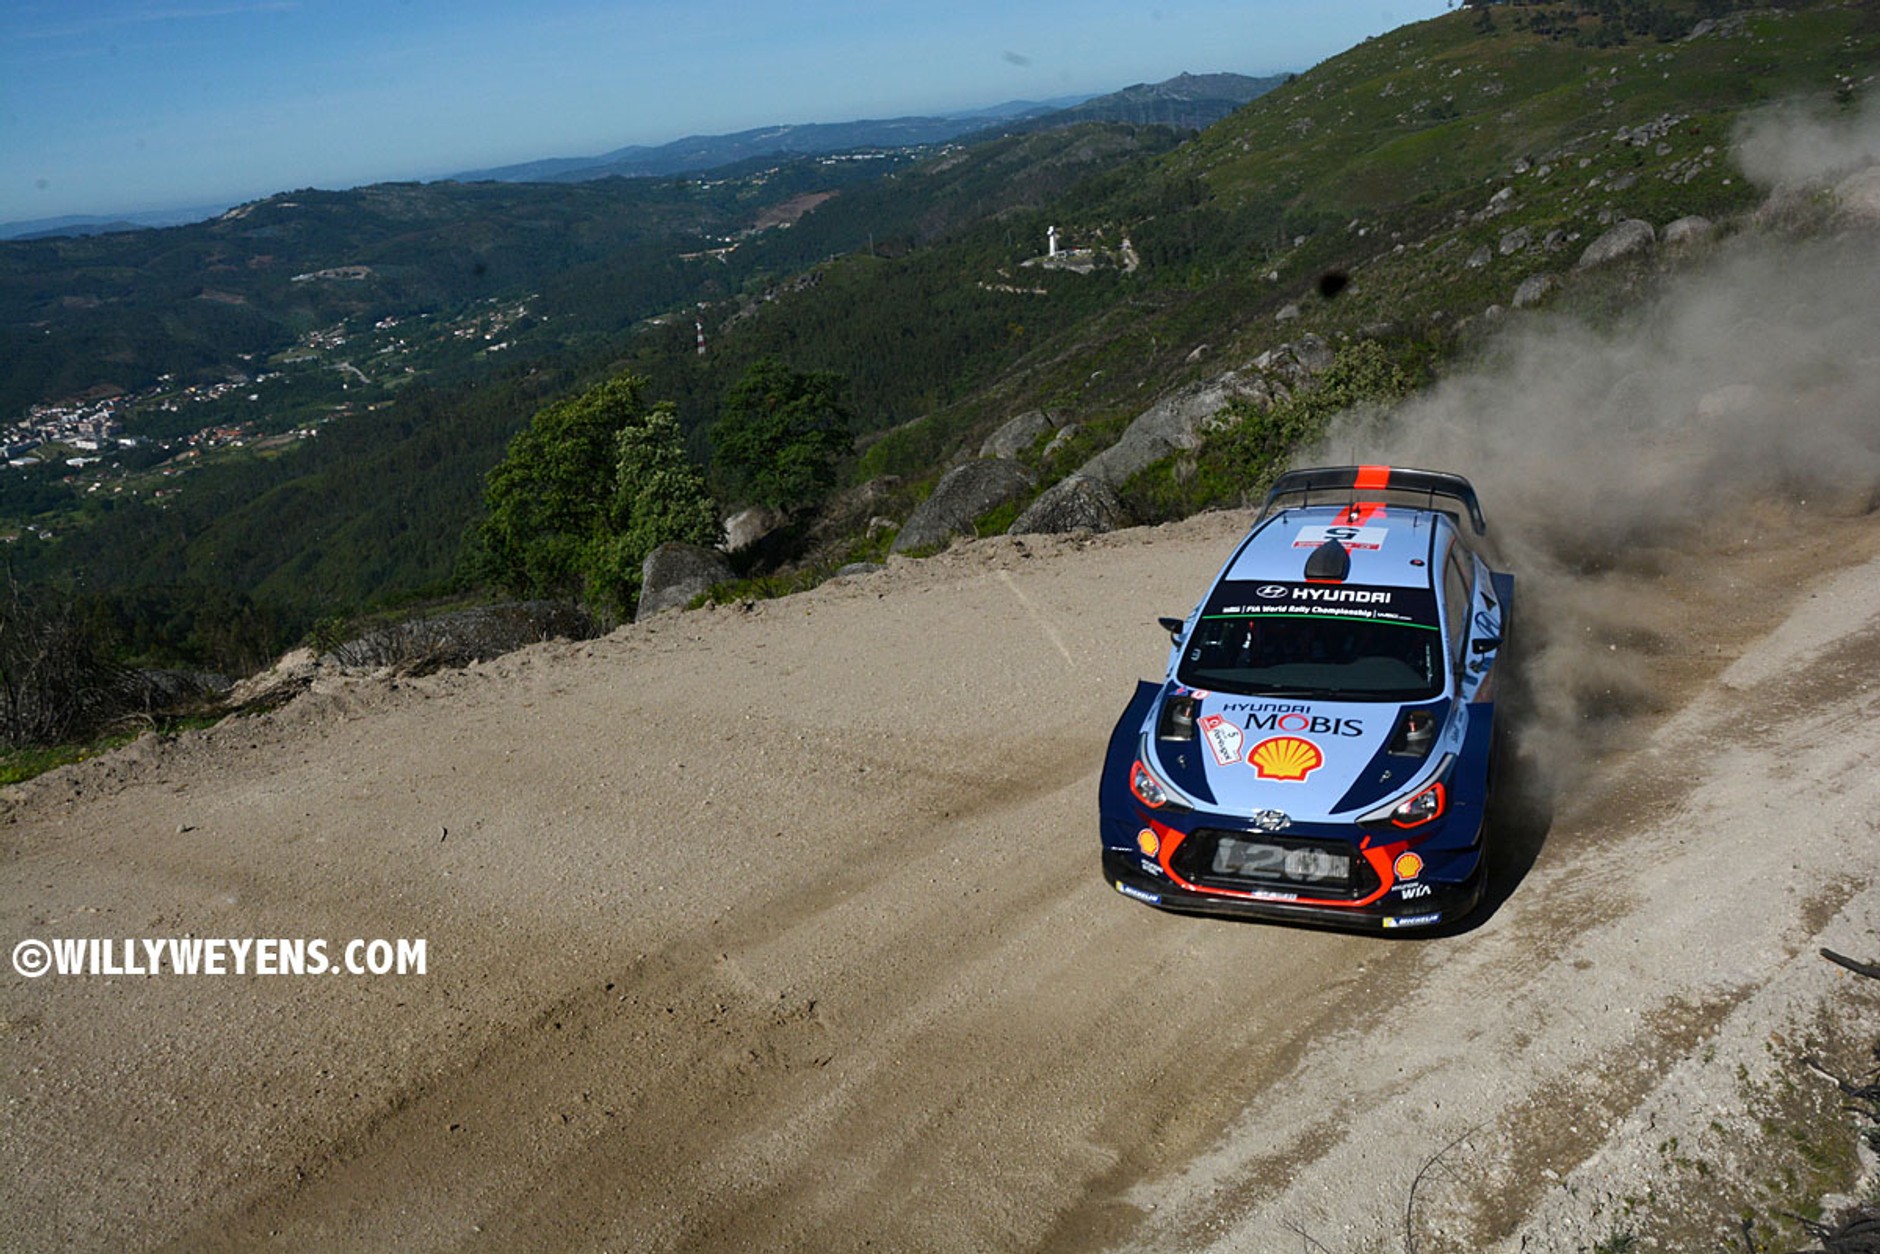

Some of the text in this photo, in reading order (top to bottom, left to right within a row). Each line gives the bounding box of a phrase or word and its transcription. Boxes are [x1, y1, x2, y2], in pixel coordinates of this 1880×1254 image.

[1292, 587, 1391, 603] HYUNDAI
[1262, 605, 1288, 613] World
[1288, 605, 1310, 614] Rally
[1311, 606, 1372, 618] Championship
[1223, 703, 1311, 715] HYUNDAI
[1245, 713, 1363, 737] MOBIS
[1401, 884, 1431, 900] WIA
